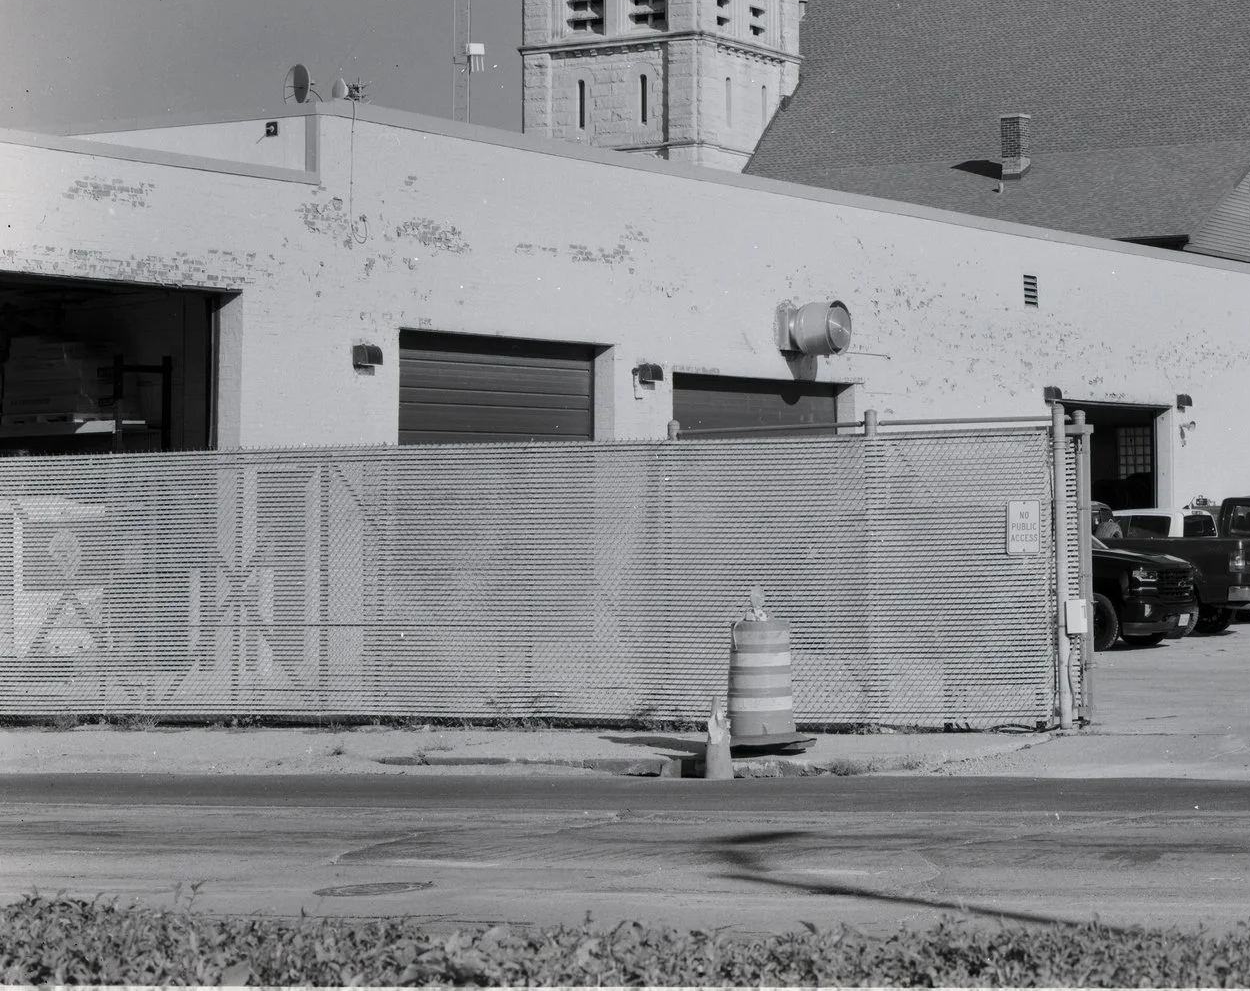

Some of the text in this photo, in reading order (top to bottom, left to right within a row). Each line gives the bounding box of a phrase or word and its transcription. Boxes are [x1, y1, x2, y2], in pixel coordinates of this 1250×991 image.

[1020, 511, 1030, 519] NO
[1011, 522, 1037, 530] PUBLIC
[1010, 534, 1038, 542] ACCESS
